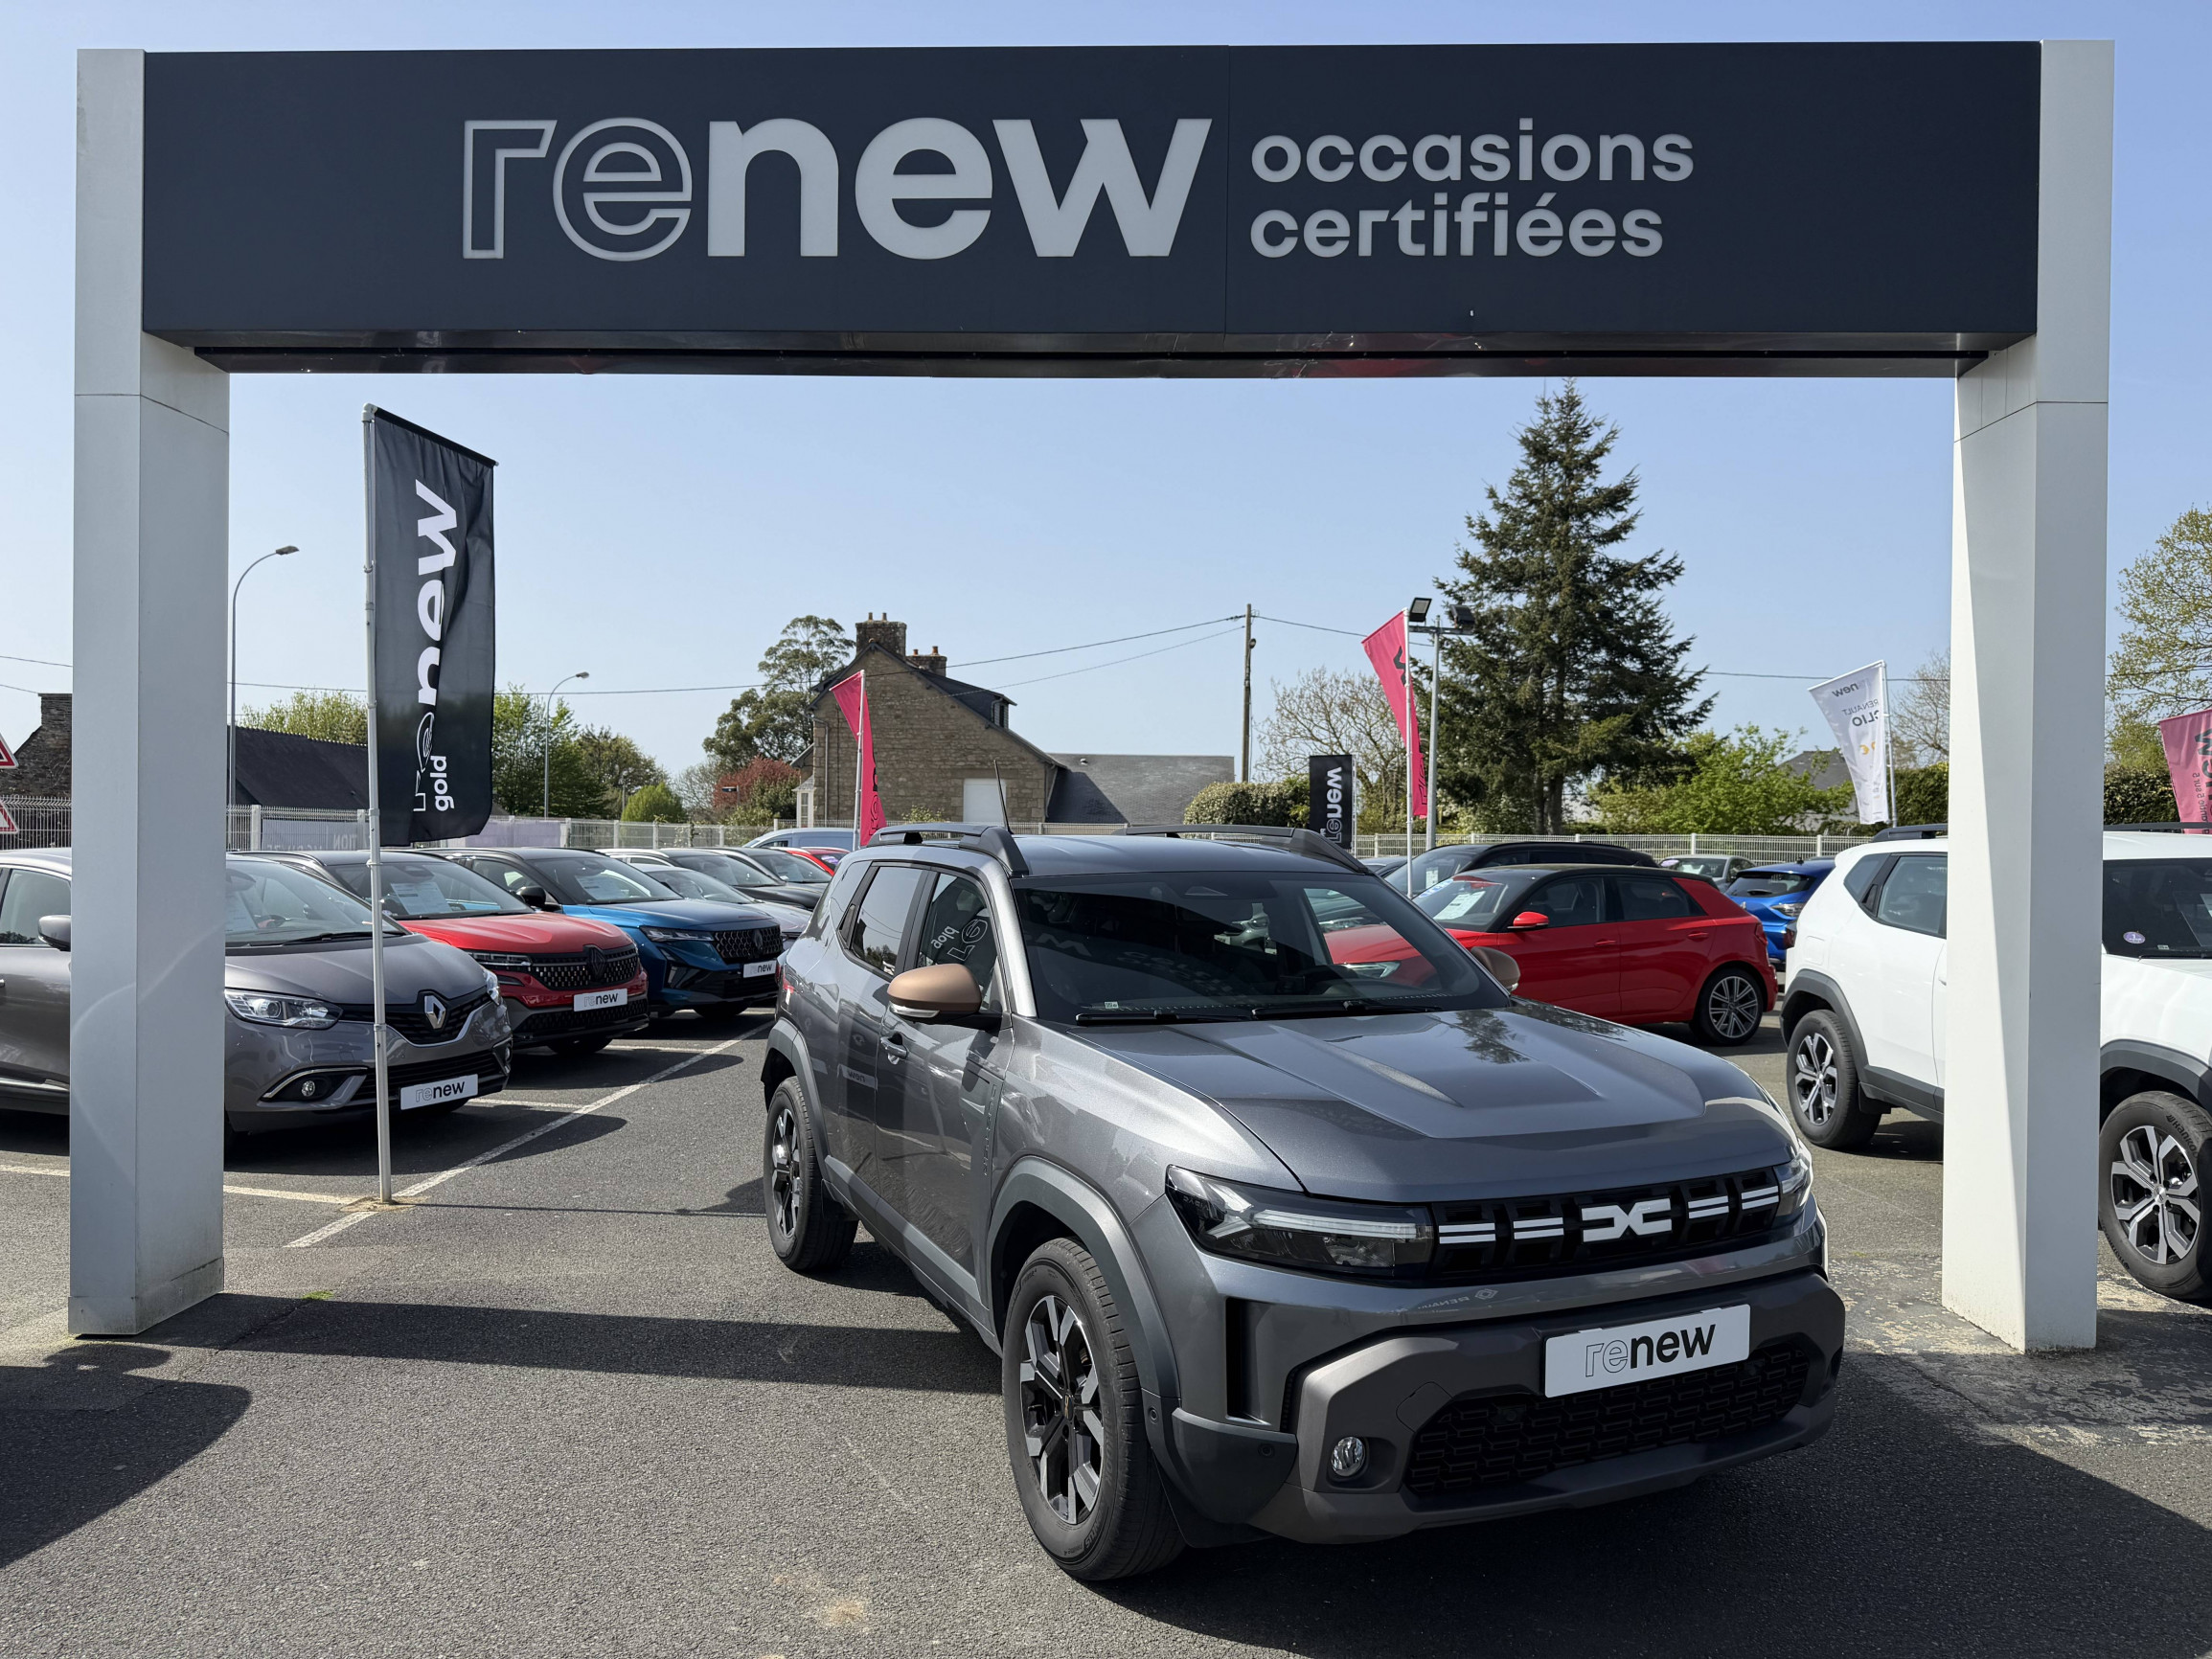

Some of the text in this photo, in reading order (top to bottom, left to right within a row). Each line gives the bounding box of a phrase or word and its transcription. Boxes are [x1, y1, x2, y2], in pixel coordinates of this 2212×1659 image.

[1250, 117, 1695, 183] occasions
[462, 116, 1214, 261] renew
[1249, 192, 1664, 259] certifiées
[429, 755, 455, 812] gold
[583, 992, 618, 1007] renew
[415, 1081, 465, 1102] renew
[1585, 1323, 1717, 1378] renew
